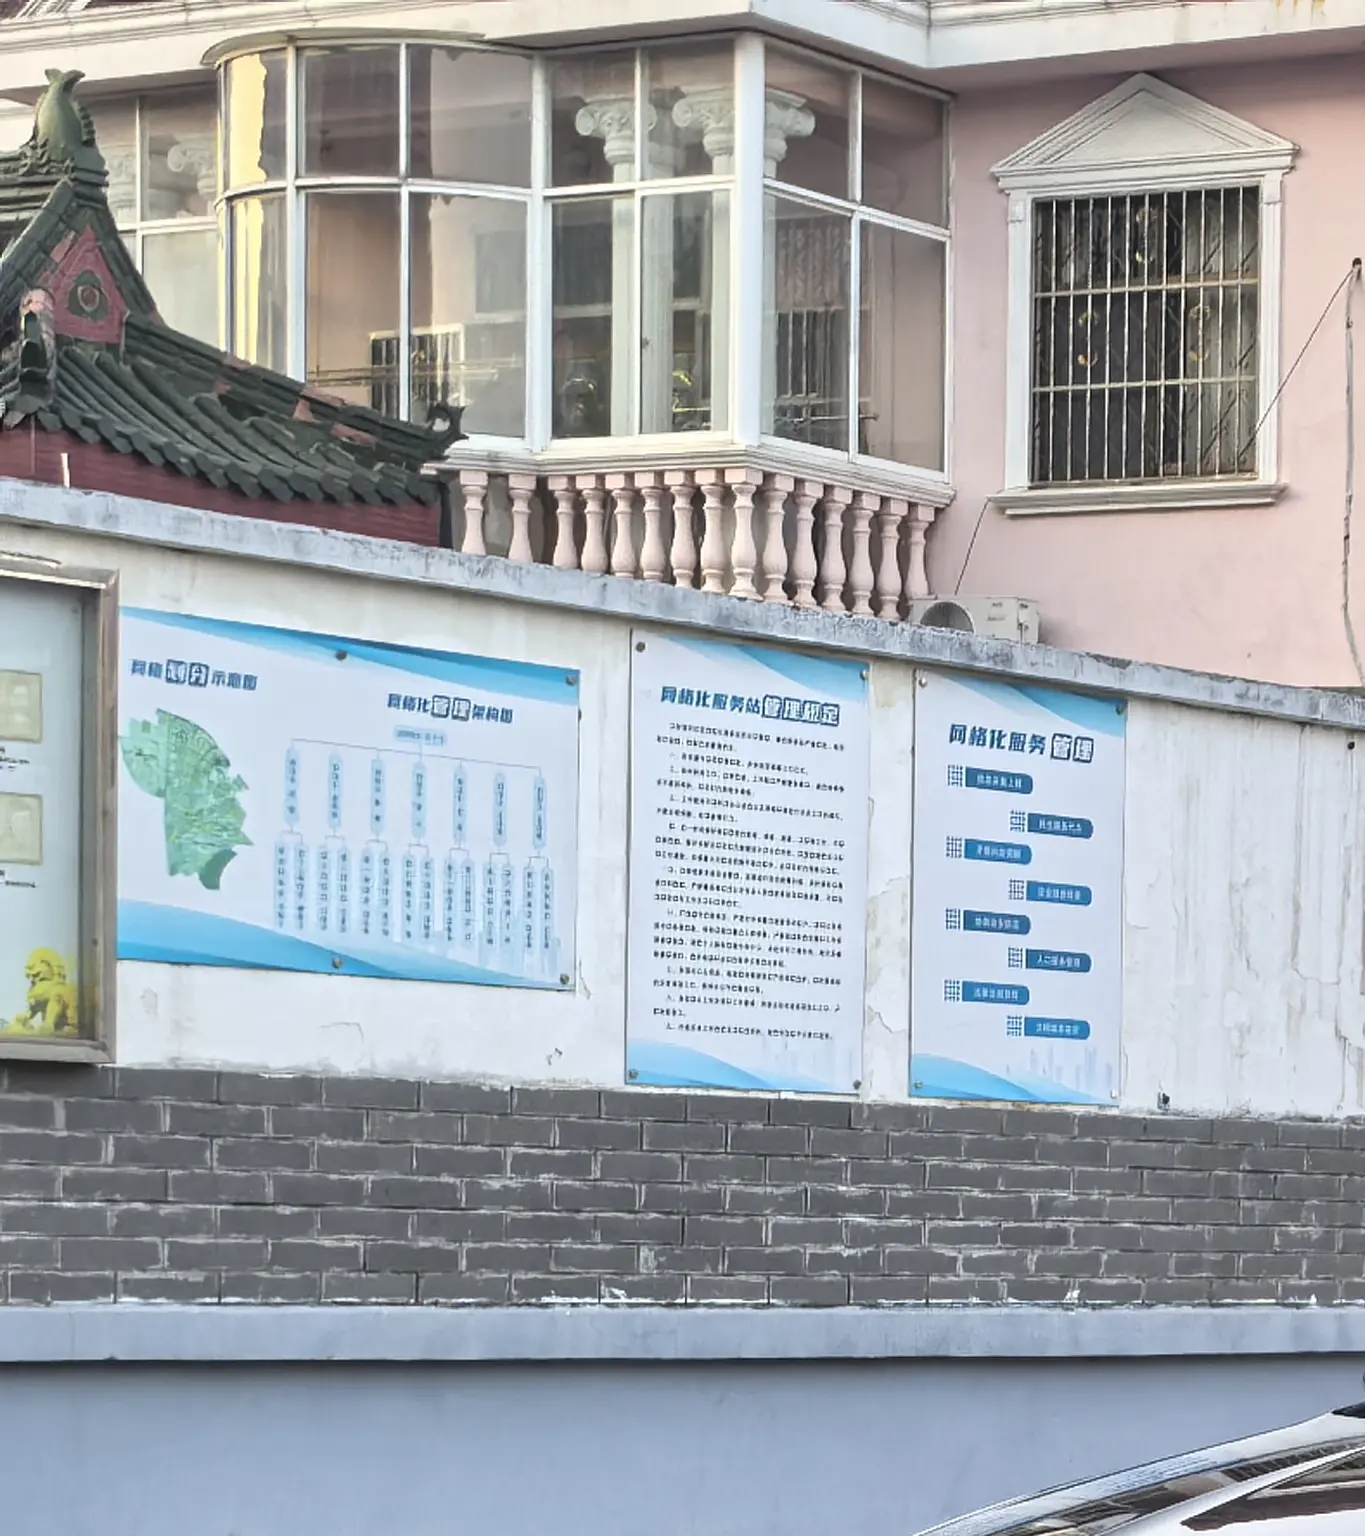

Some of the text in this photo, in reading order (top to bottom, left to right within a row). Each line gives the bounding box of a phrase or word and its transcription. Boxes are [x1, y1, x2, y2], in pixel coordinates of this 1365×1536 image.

[661, 686, 840, 727] 网格化服务站管理规定
[949, 723, 1095, 764] 网格化服务管理
